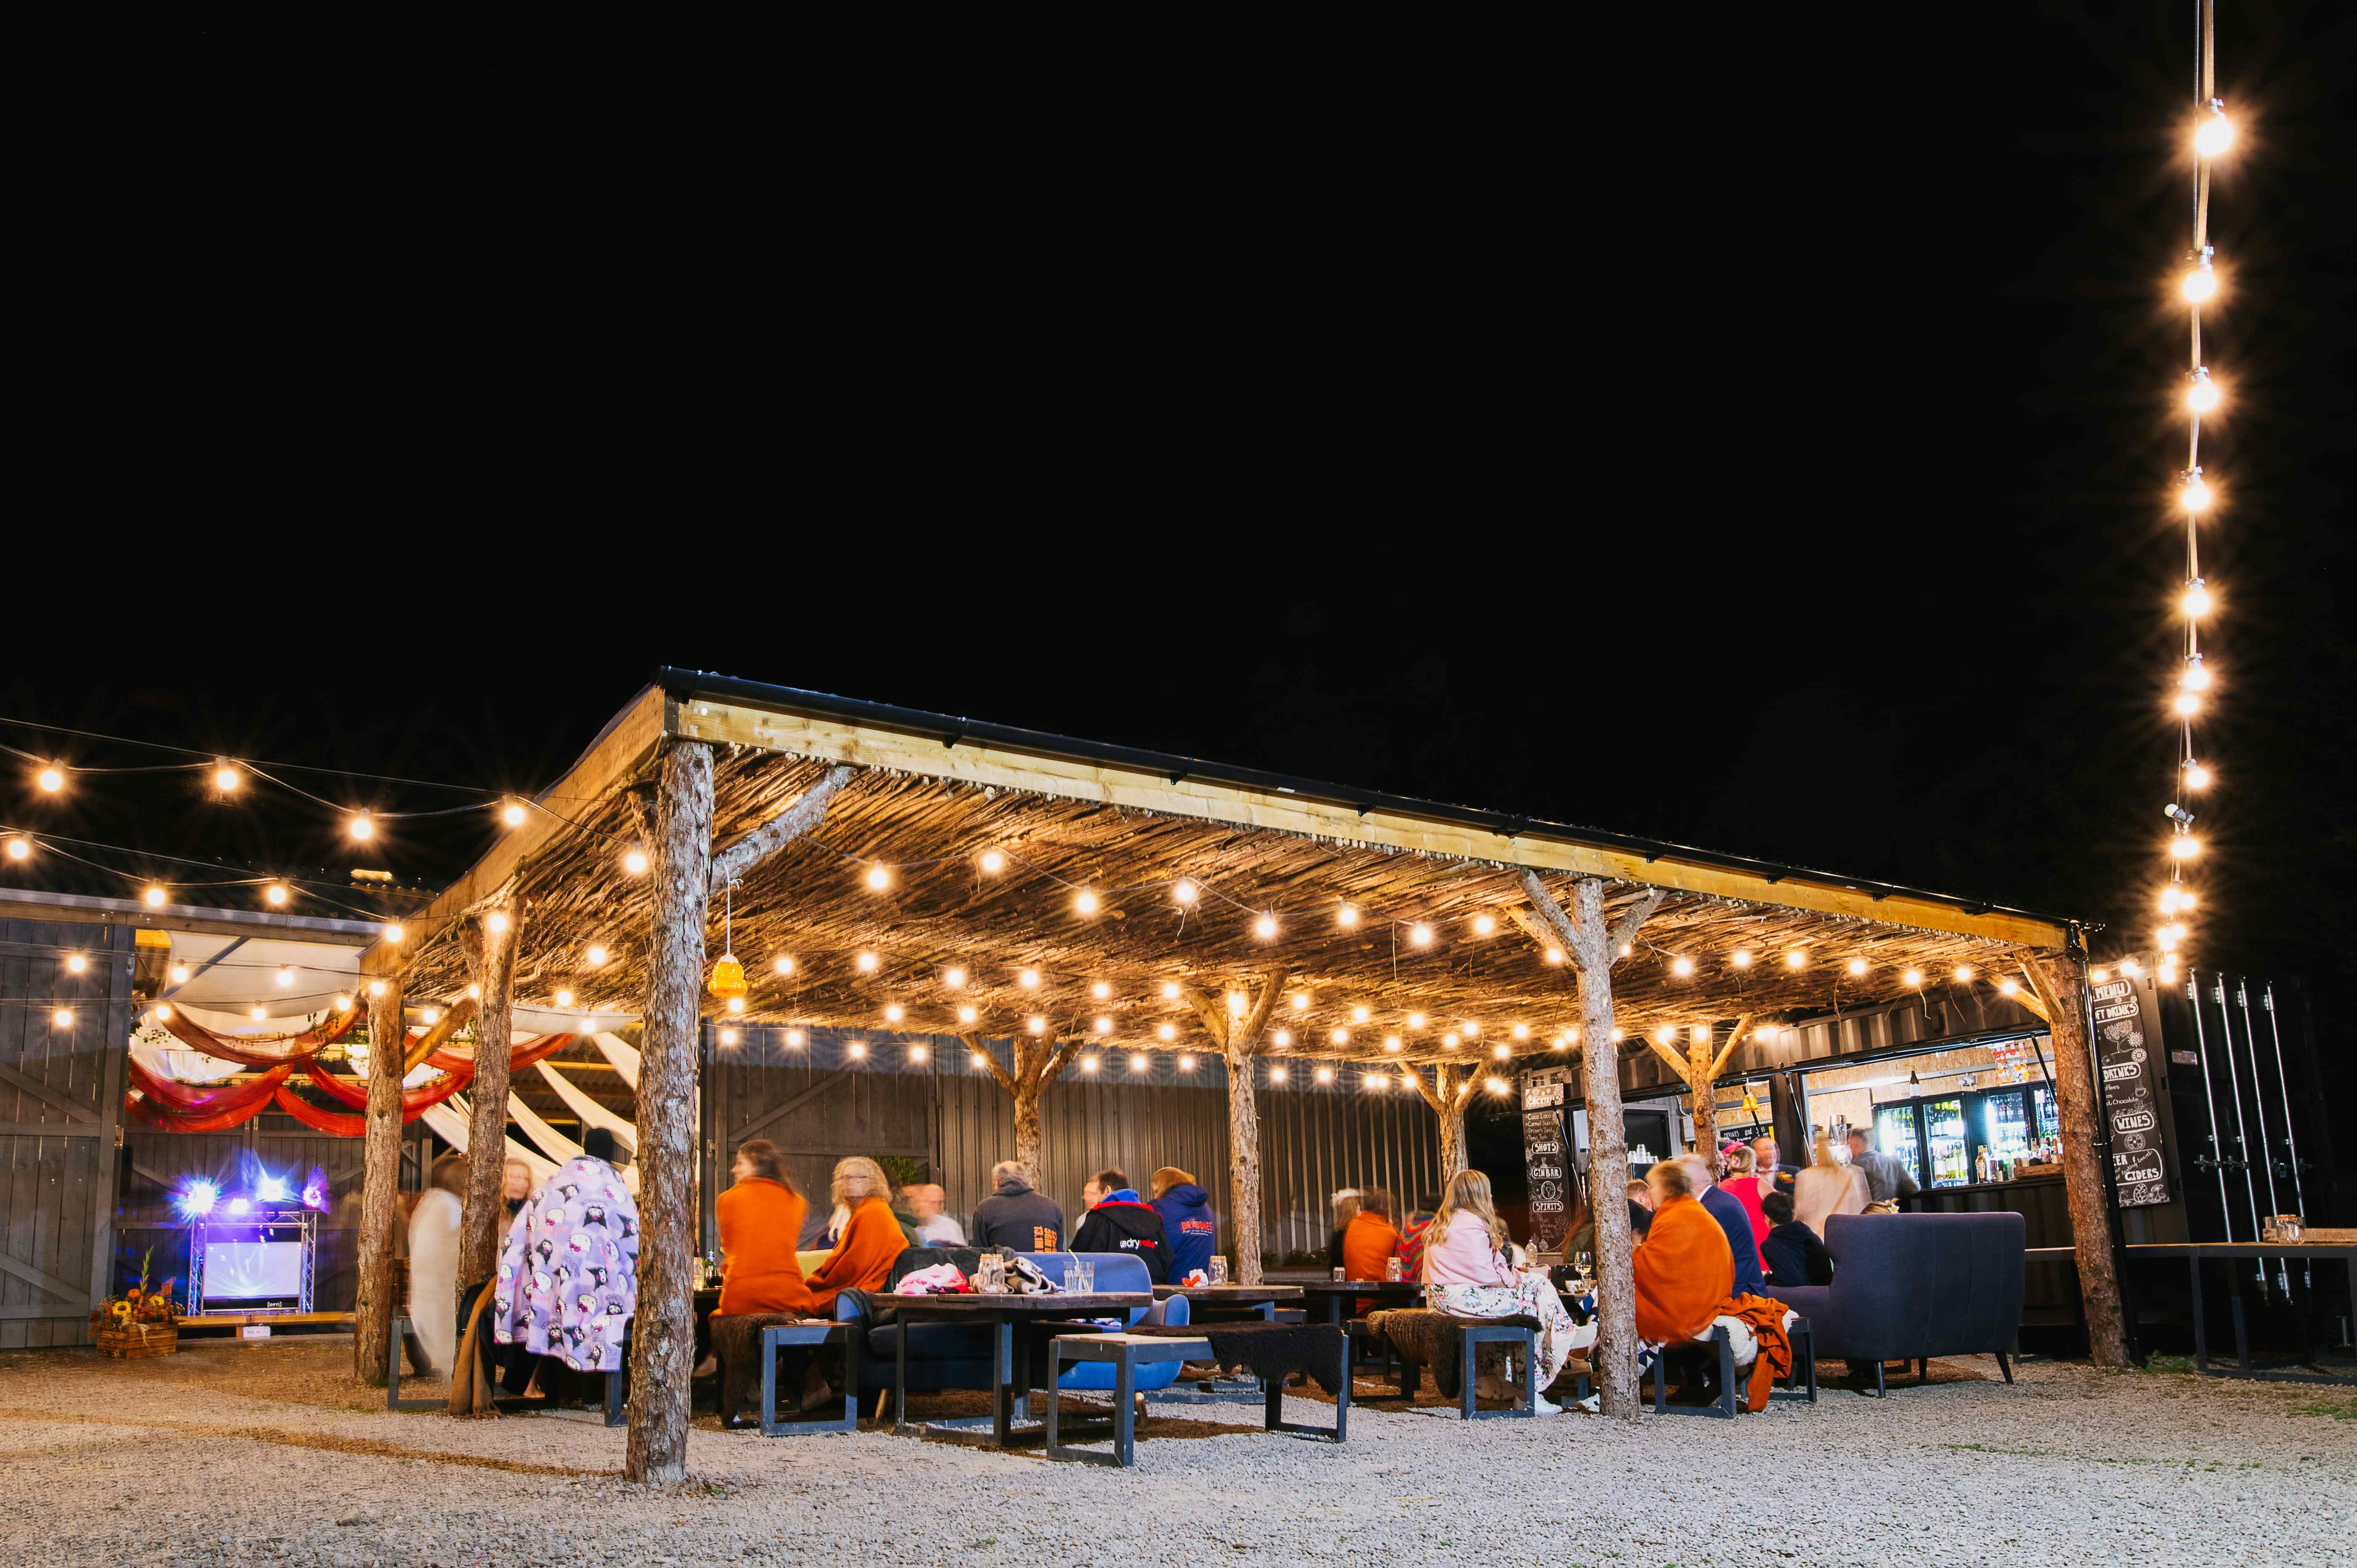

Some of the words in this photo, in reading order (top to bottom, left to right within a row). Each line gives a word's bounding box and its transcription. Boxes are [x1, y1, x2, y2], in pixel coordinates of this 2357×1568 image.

[2095, 983, 2125, 999] MENU
[2106, 1003, 2137, 1018] DRINKS
[2103, 1065, 2137, 1080] DRINKS
[2113, 1096, 2139, 1105] Chocolate
[2116, 1115, 2151, 1130] WINES
[1535, 1143, 1557, 1152] SHOTS
[2113, 1154, 2128, 1166] ER
[1546, 1168, 1559, 1177] BAR
[2125, 1168, 2159, 1181] CIDERS
[1536, 1202, 1562, 1210] SPIRITS
